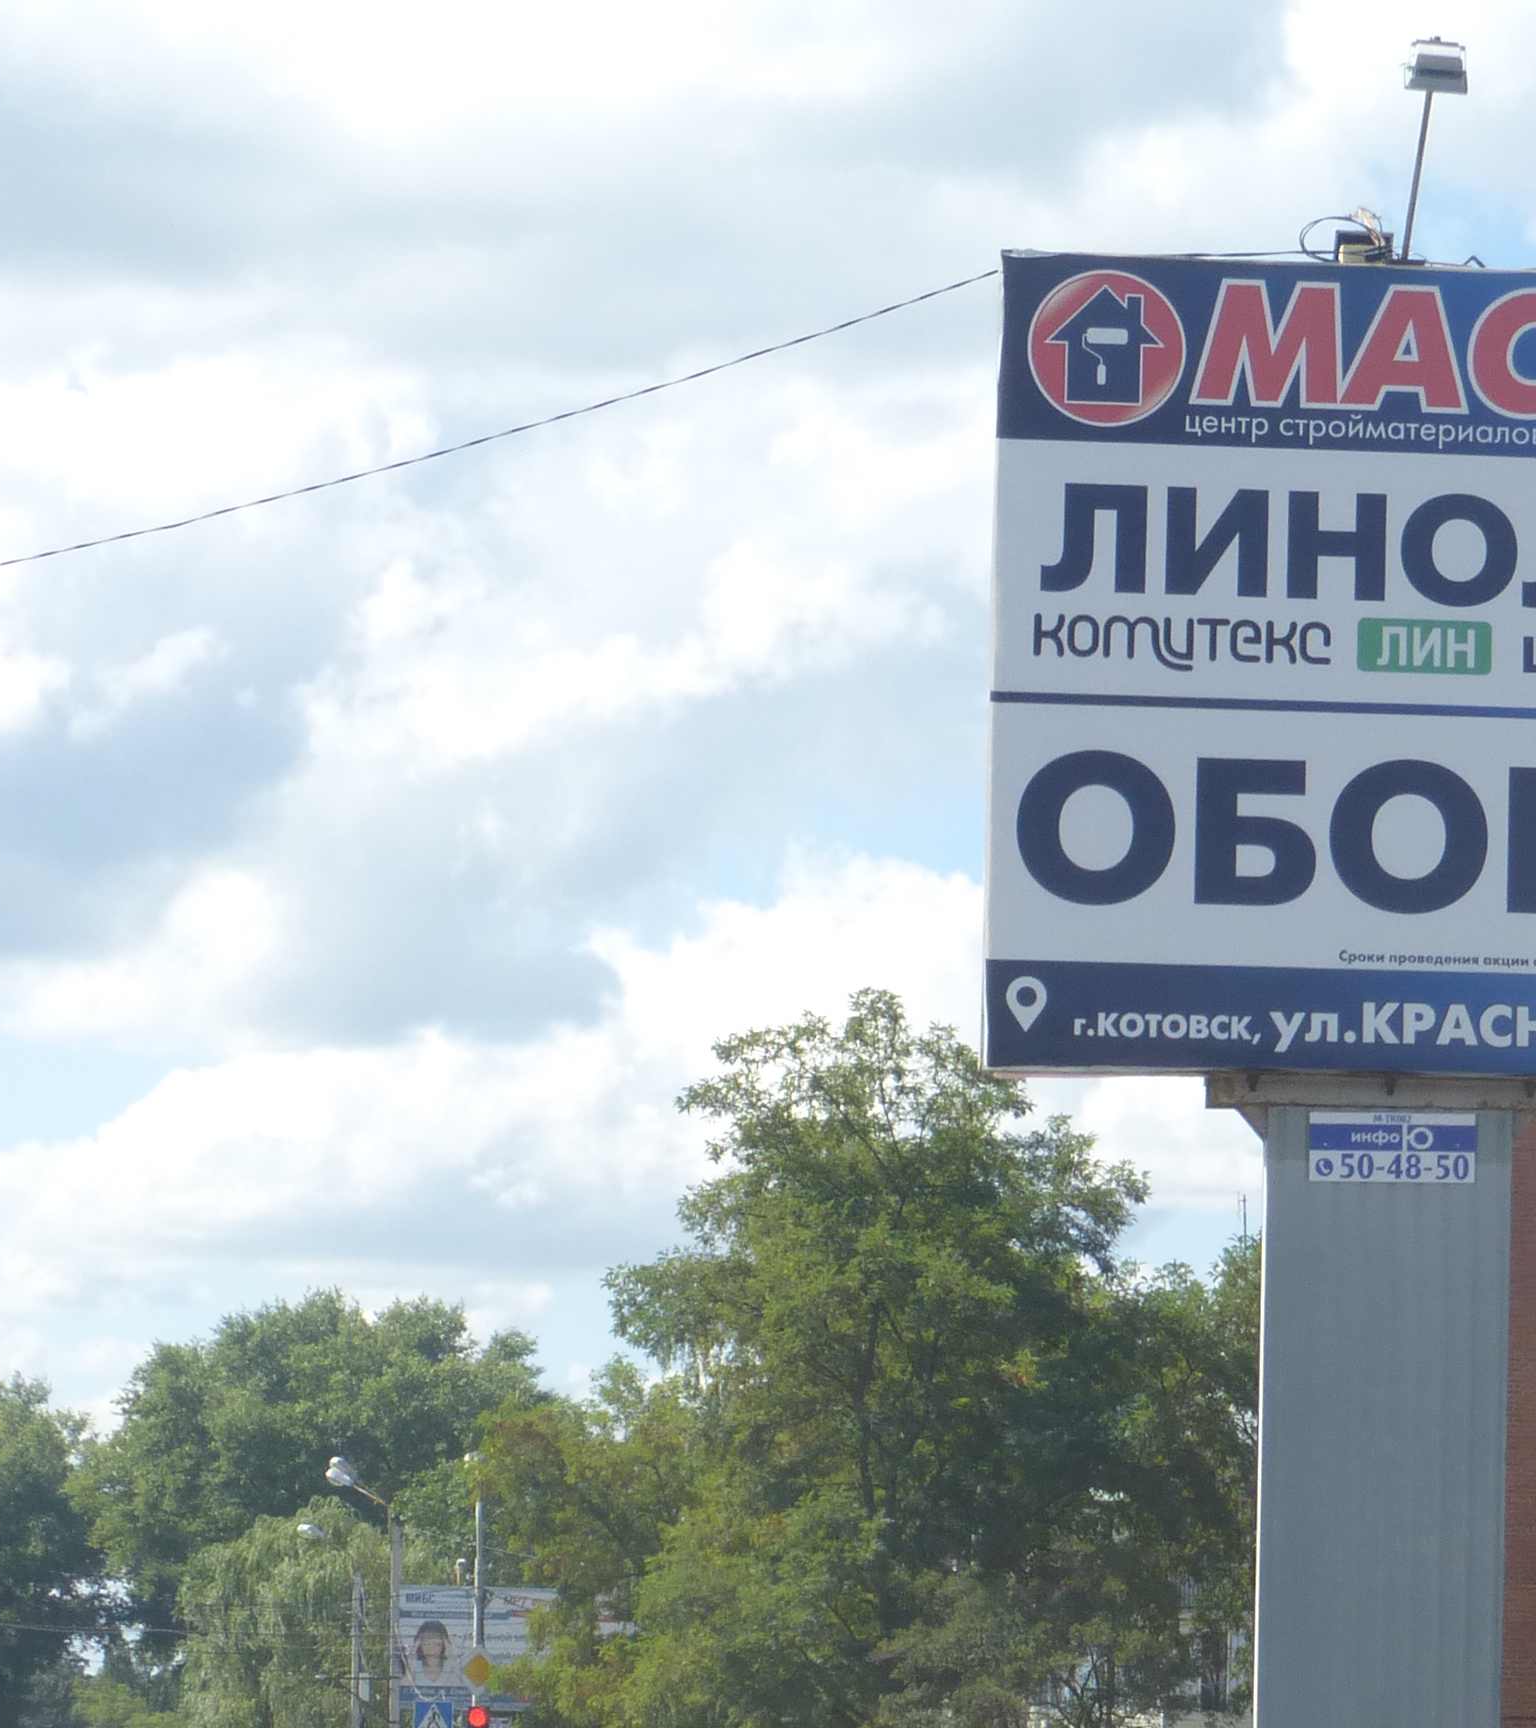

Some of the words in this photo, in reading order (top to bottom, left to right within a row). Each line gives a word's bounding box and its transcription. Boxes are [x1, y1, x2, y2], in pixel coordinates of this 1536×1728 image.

[1185, 413, 1269, 437] центр
[1376, 626, 1478, 671] ЛИН
[1338, 949, 1385, 967] Сроки
[1388, 953, 1480, 969] проведения
[1483, 956, 1529, 970] акции
[1073, 1012, 1261, 1045] г.КОТОВСК,
[1339, 1152, 1469, 1180] 50-48-50
